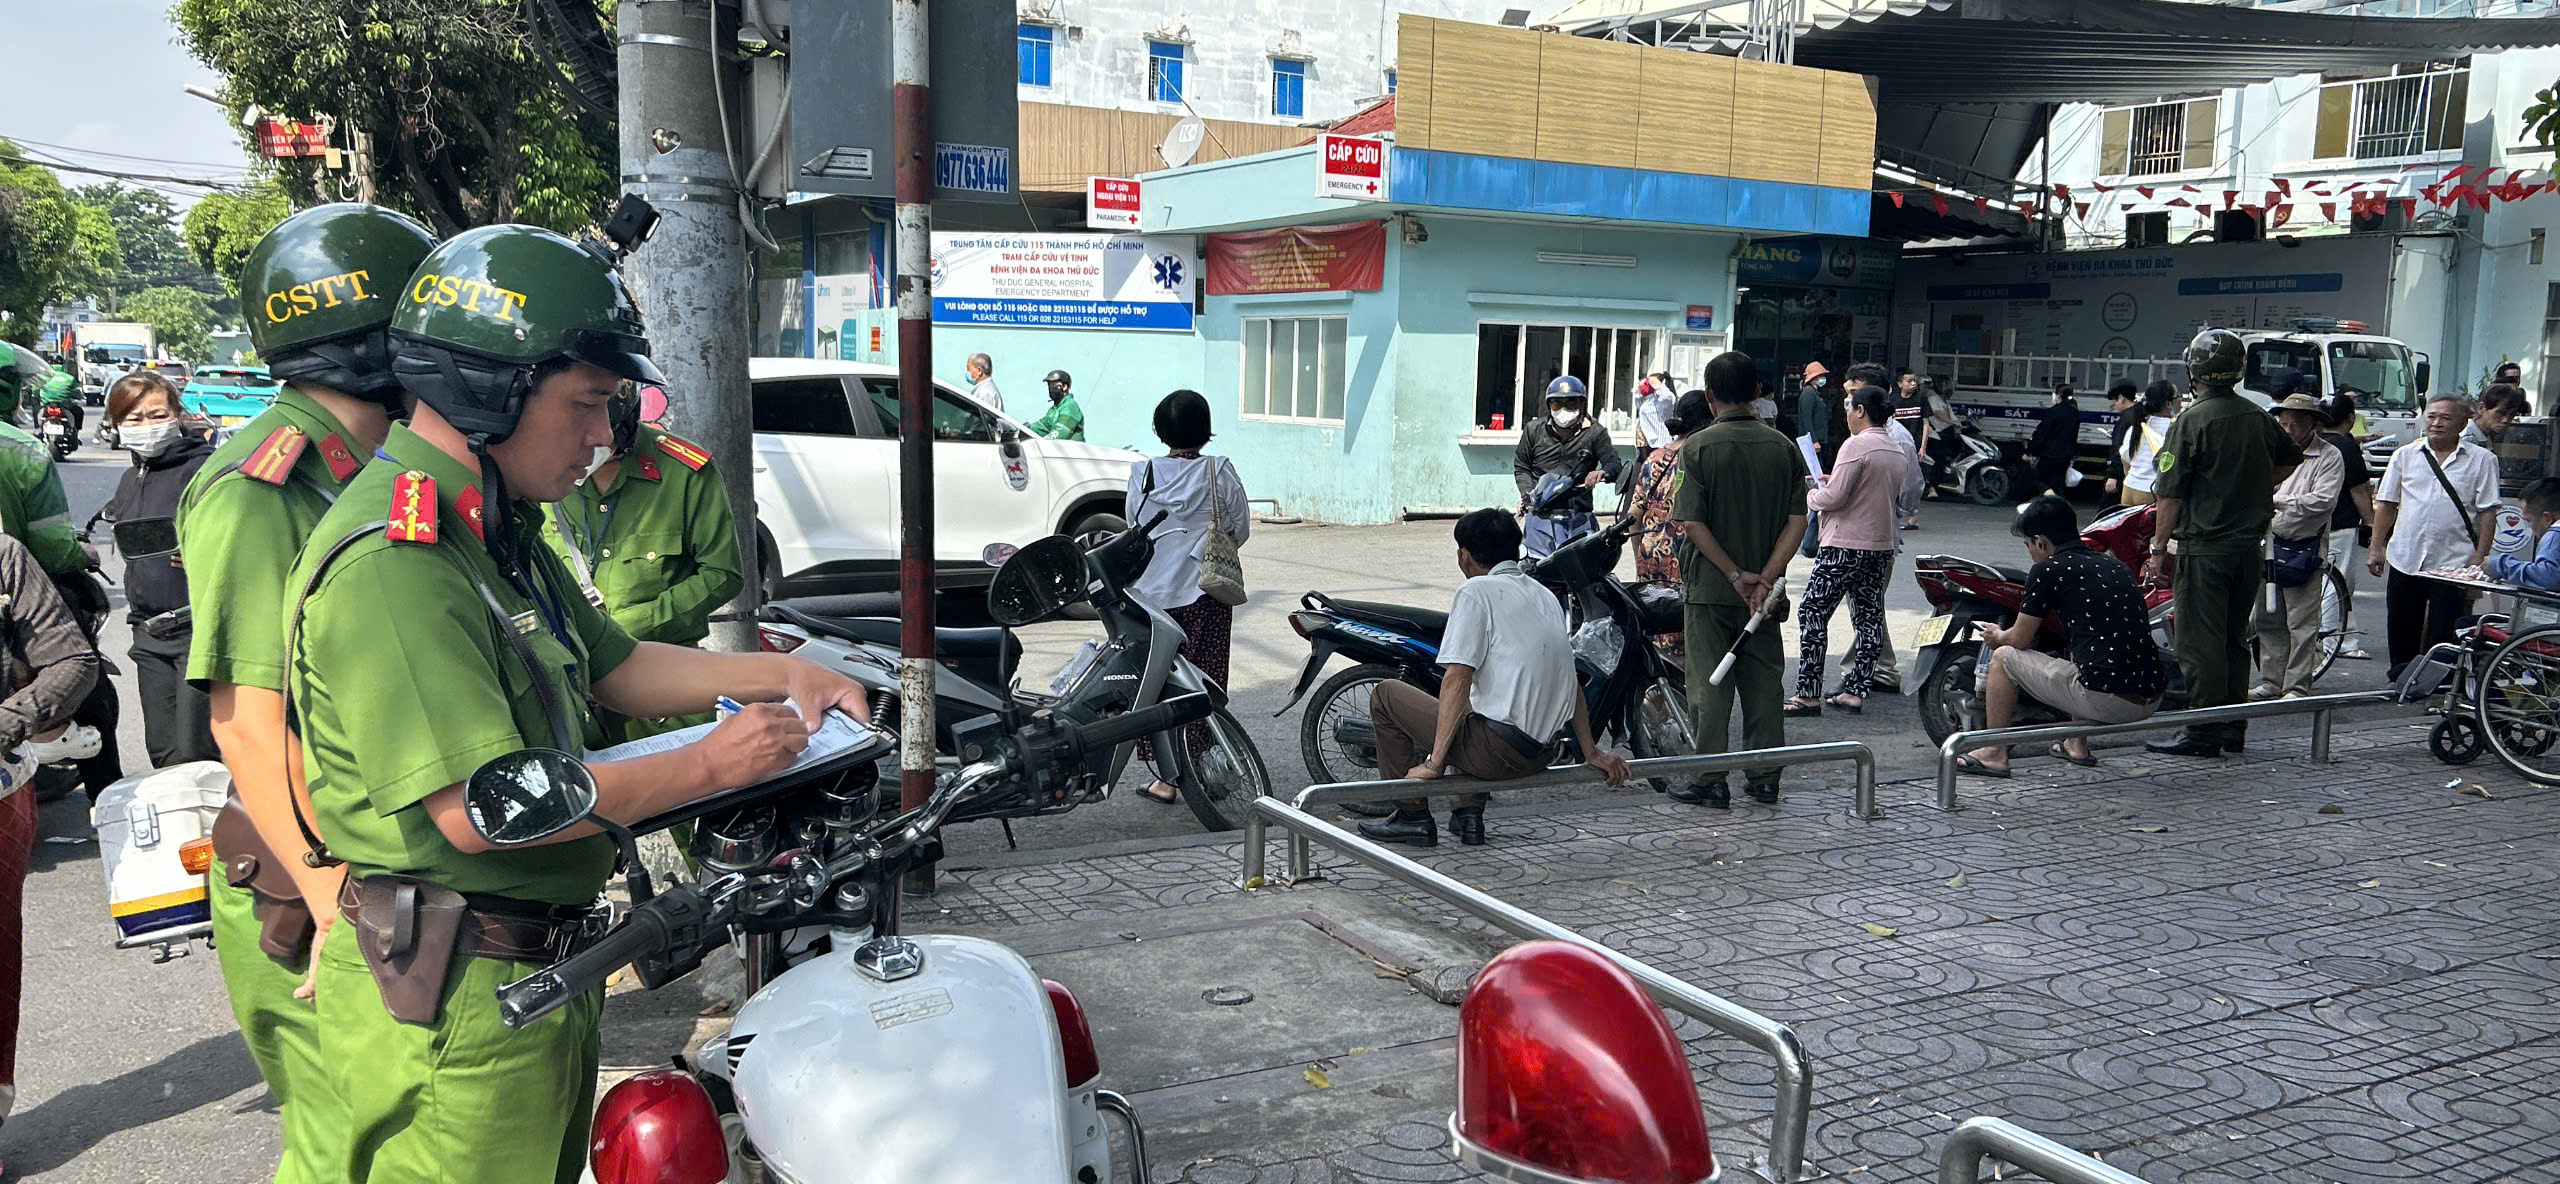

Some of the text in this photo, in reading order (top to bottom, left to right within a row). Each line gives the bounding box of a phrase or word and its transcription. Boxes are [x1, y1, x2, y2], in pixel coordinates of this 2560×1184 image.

[1328, 139, 1379, 164] CẤP CỨU
[936, 152, 1007, 192] 0977.636.444
[1105, 182, 1117, 191] CẤP
[1328, 181, 1363, 190] EMERGENCY
[1096, 213, 1127, 222] PARAMEDIC
[950, 240, 975, 248] TRUNG
[976, 239, 992, 249] TÂM
[994, 238, 1010, 249] CẤP
[1012, 239, 1028, 249] CỨU
[1031, 241, 1044, 249] 115
[1046, 240, 1072, 249] THÀNH
[1107, 239, 1121, 250] CHÍ
[1123, 242, 1144, 250] MINH
[1024, 250, 1040, 261] CẤP
[1042, 252, 1058, 262] CỨU
[1043, 267, 1064, 275] KHOA
[1024, 279, 1058, 287] GENERAL
[1059, 280, 1094, 288] HOSPITAL
[265, 270, 370, 323] CSTT
[413, 274, 527, 321] CSTT
[995, 288, 1090, 297] EMERGENCY DEPARTMENT
[944, 302, 956, 311] VUI
[957, 301, 976, 311] LÒNG
[1004, 303, 1016, 312] 115
[1053, 305, 1086, 314] 22153115
[972, 313, 998, 321] PLEASE
[999, 313, 1015, 322] CALL
[1017, 314, 1028, 322] 115
[1029, 314, 1039, 322] OR
[1040, 315, 1051, 323] 028
[1052, 315, 1083, 324] 22153115
[1099, 317, 1117, 325] HELP
[2004, 407, 2031, 418] SÁT
[1103, 673, 1138, 681] HONDA
